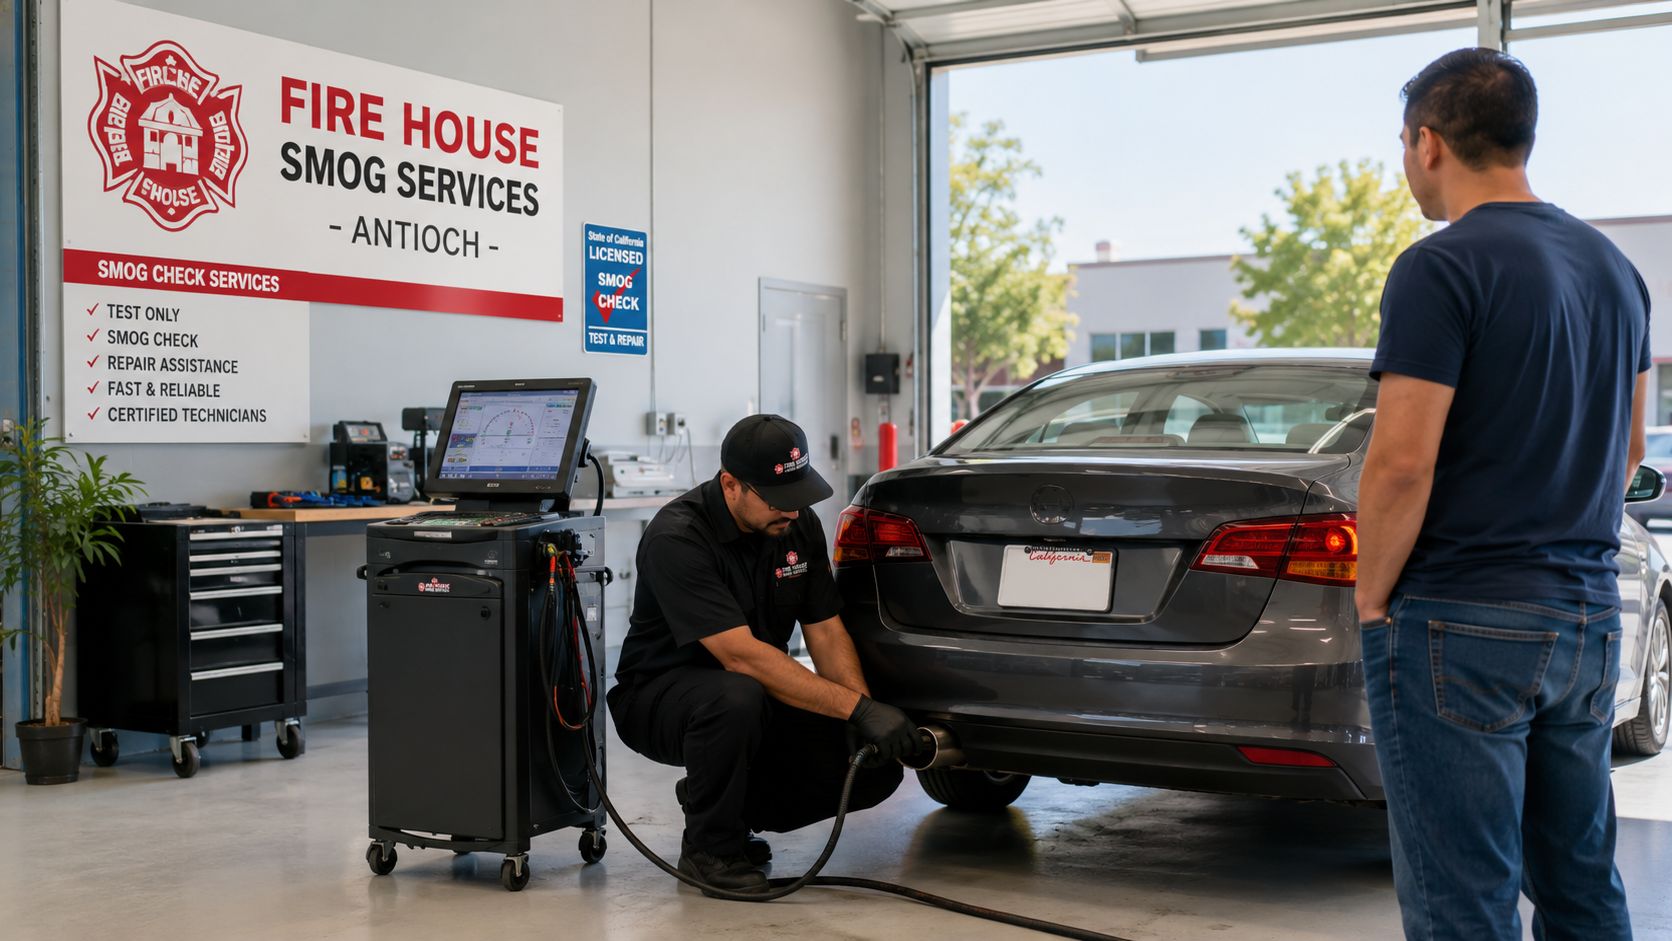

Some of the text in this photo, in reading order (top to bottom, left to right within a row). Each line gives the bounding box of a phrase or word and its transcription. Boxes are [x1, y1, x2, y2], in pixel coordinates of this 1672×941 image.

[280, 76, 540, 169] FIRE HOUSE
[280, 141, 386, 194] SMOG
[397, 161, 540, 216] SERVICES
[351, 215, 479, 258] ANTIOCH
[588, 230, 644, 247] State of California
[589, 245, 643, 265] LICENSED
[97, 259, 280, 293] SMOG CHECK SERVICES
[598, 272, 633, 289] SMOG
[598, 294, 640, 311] CHECK
[107, 303, 180, 322] TEST ONLY
[107, 329, 199, 348] SMOG CHECK
[588, 332, 608, 345] TEST
[617, 334, 644, 347] REPAIR
[108, 355, 239, 374] REPAIR ASSISTANCE
[108, 381, 221, 398] FAST & RELIABLE
[108, 407, 267, 423] CERTIFIED TECHNICIANS
